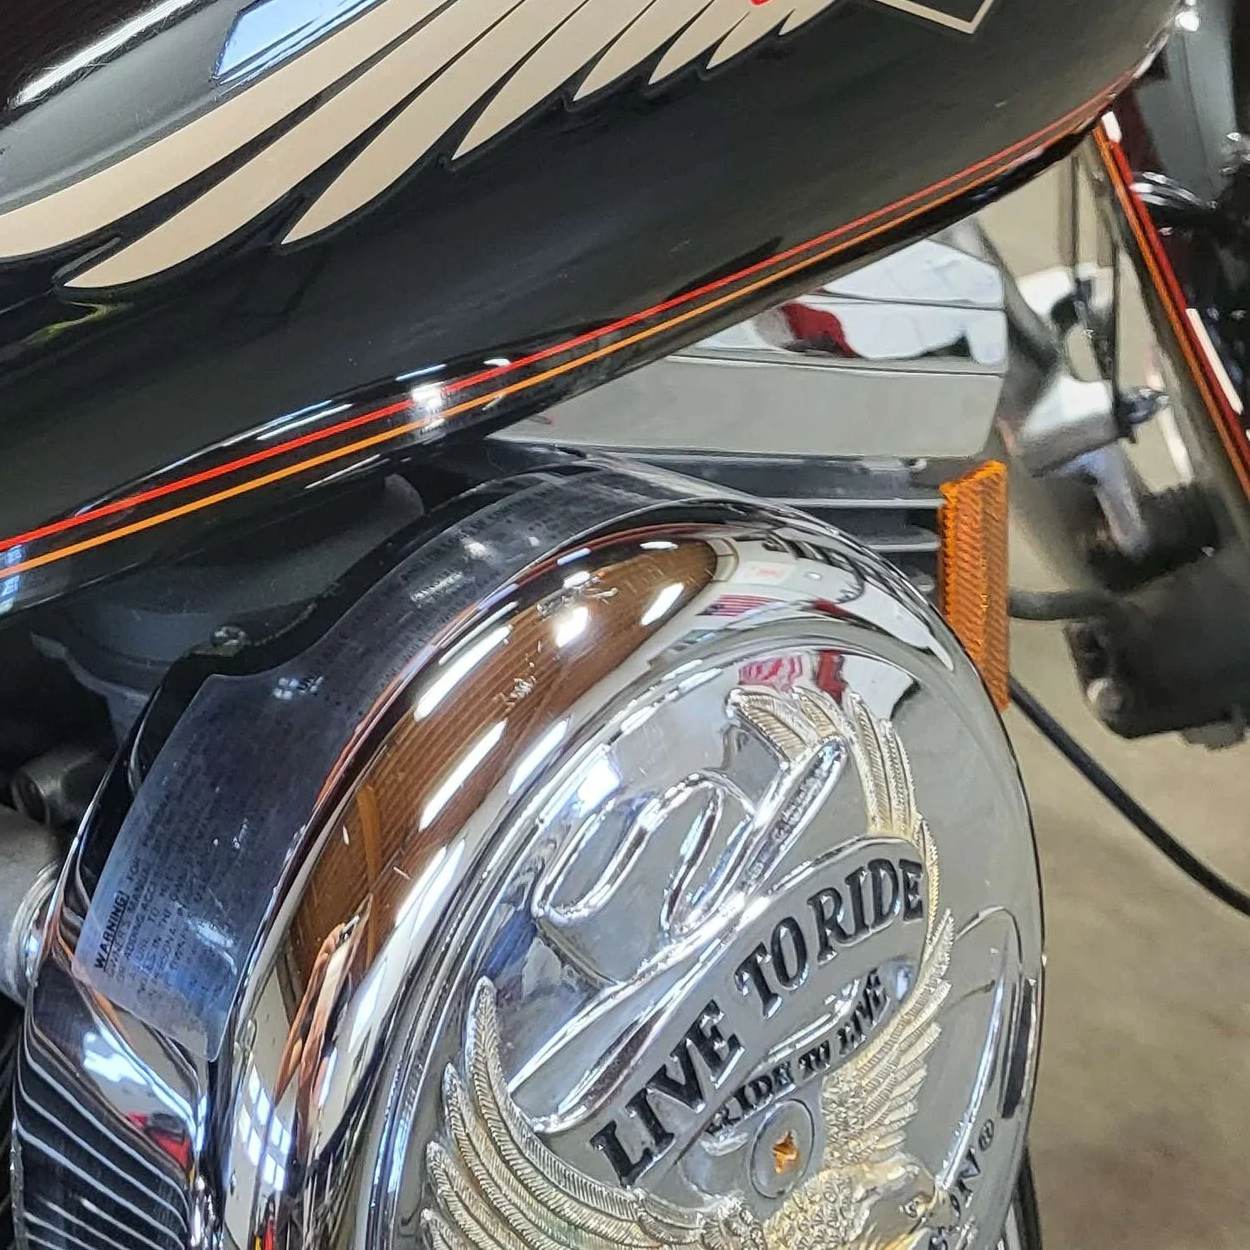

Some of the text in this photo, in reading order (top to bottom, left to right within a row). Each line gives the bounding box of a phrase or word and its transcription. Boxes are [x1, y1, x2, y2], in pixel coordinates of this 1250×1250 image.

[93, 889, 130, 967] WARNING!
[590, 858, 924, 1188] LIVE TO RIDE
[705, 967, 891, 1136] RIDE TO LIVE
